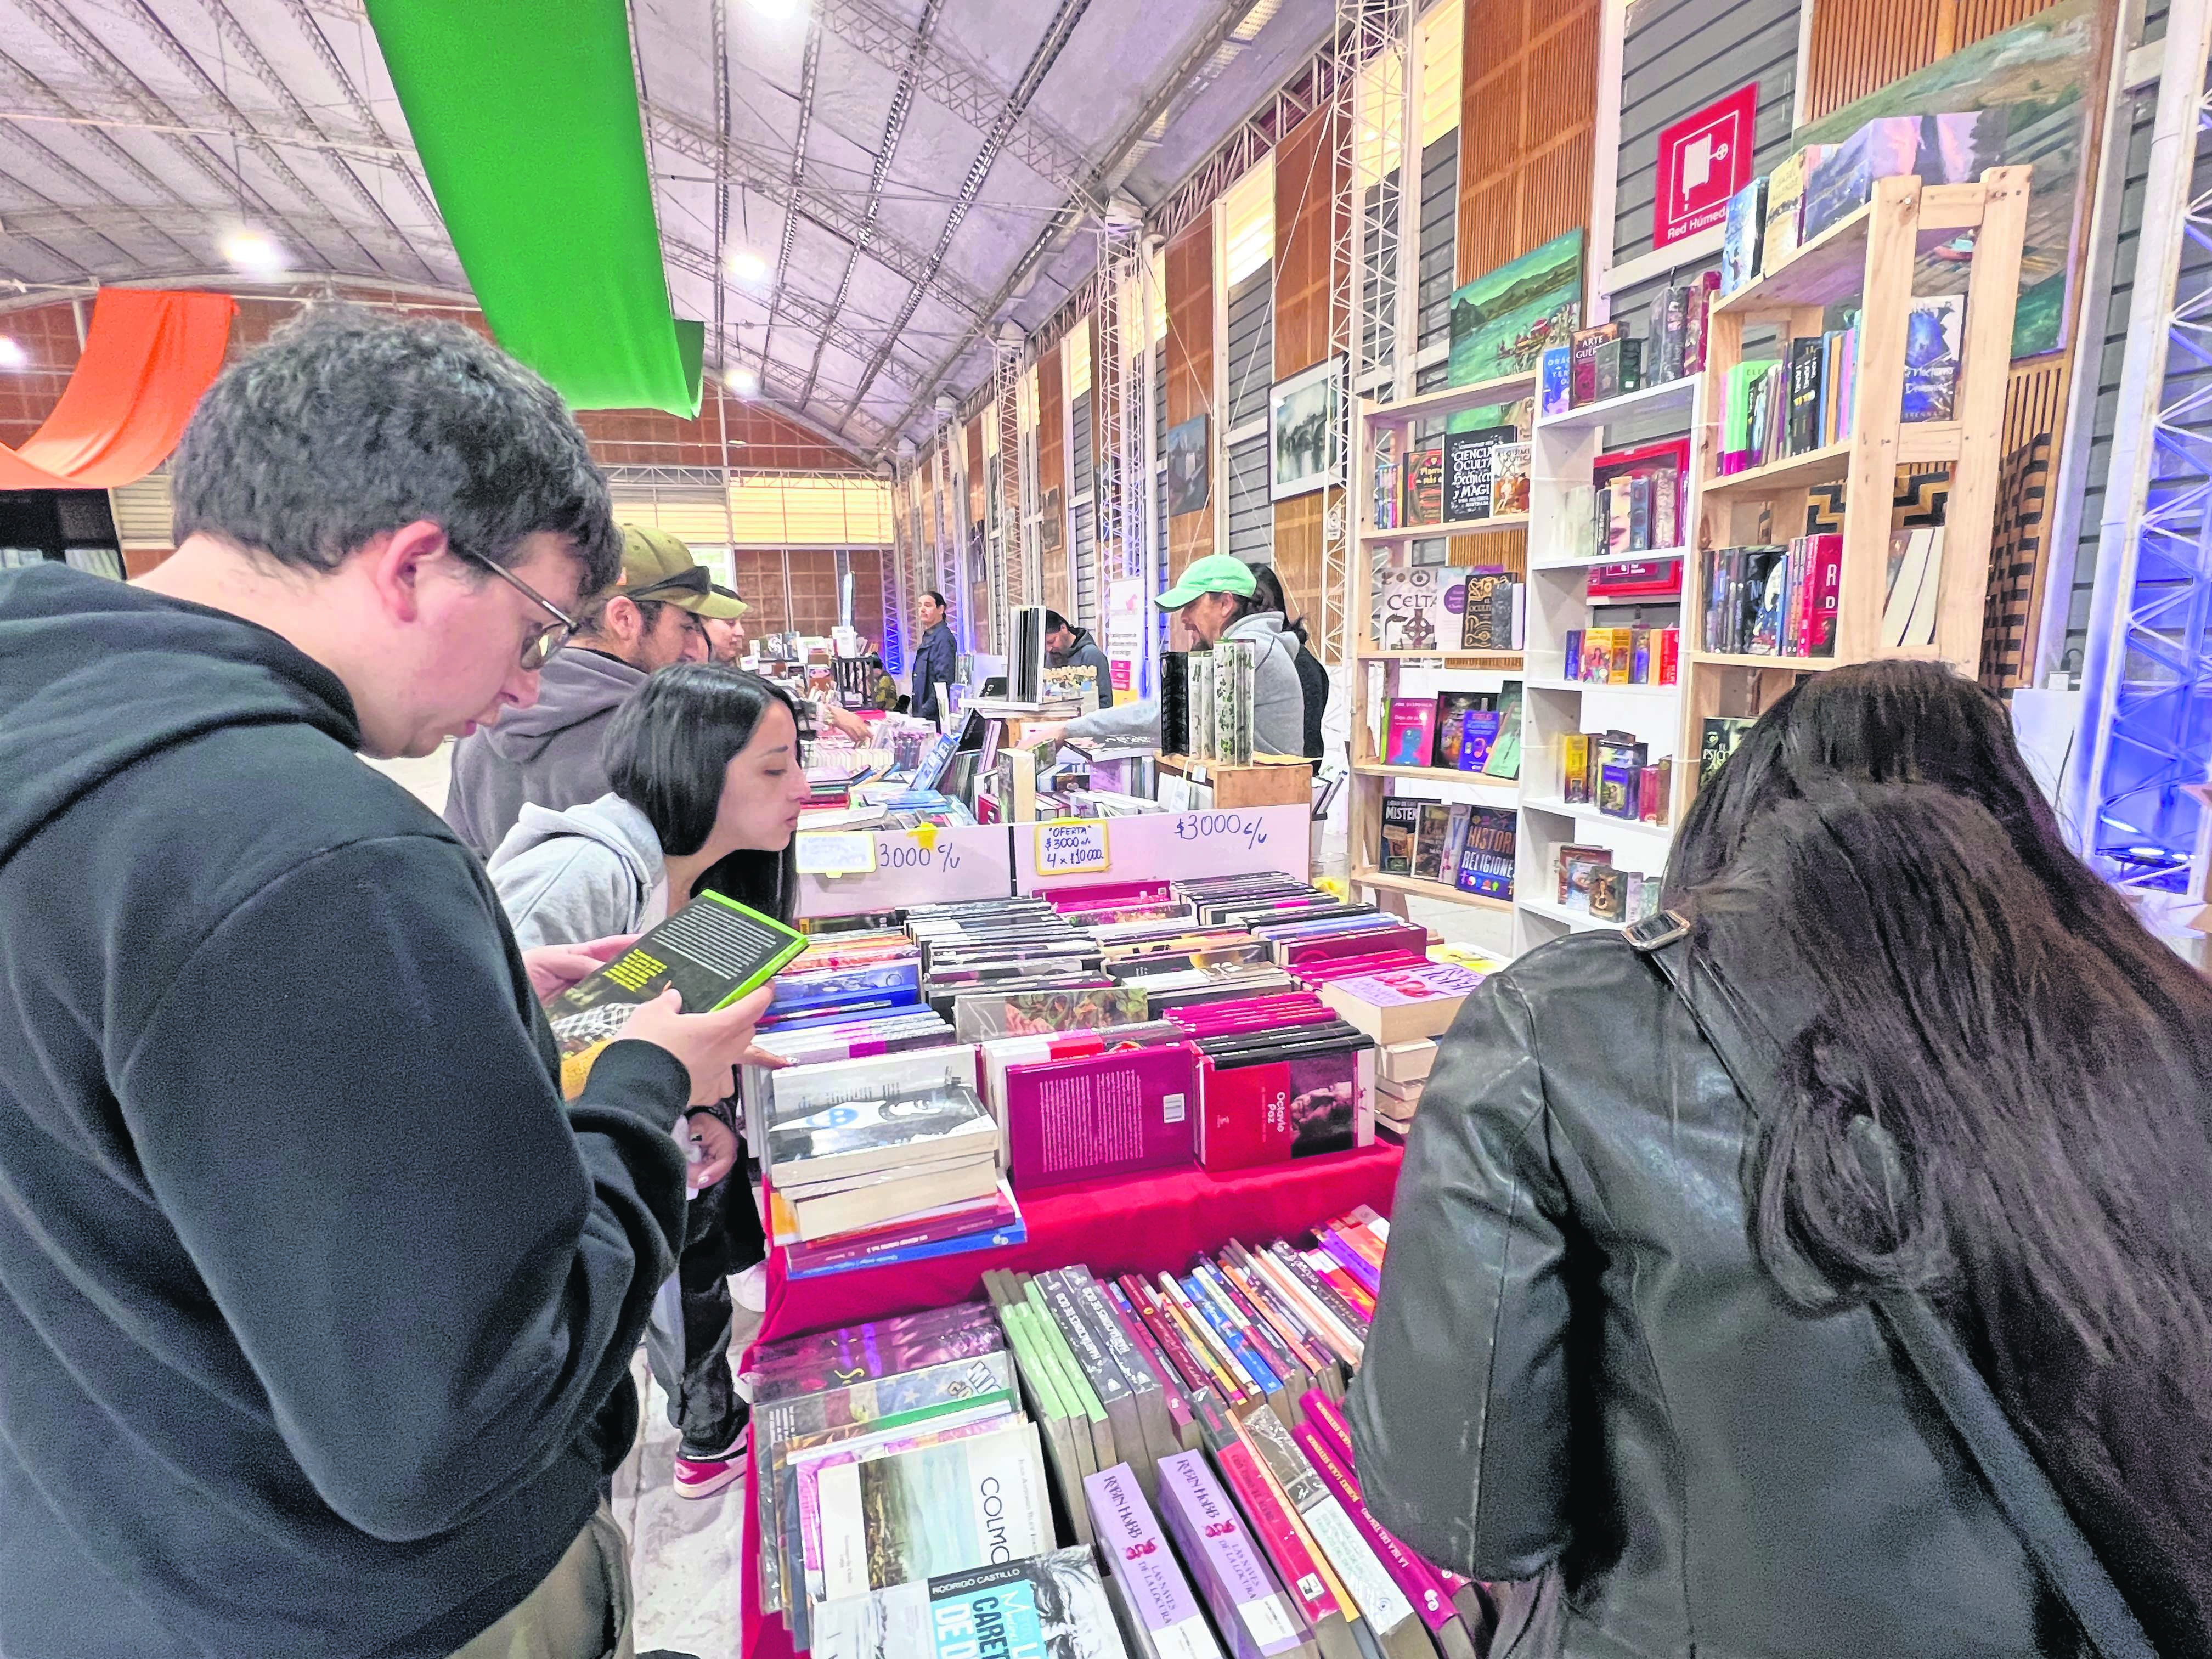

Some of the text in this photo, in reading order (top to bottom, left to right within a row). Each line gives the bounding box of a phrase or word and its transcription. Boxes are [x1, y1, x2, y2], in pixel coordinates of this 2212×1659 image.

[1668, 205, 1726, 240] Red Húmed
[1582, 335, 1603, 347] ARTE
[1460, 484, 1490, 498] MAGI
[1173, 815, 1241, 840] $3000
[1047, 853, 1057, 868] 4
[1267, 1104, 1277, 1124] Paz
[1276, 1092, 1286, 1132] Octavio
[1176, 1459, 1202, 1488] ROBIN
[1305, 1433, 1361, 1502] ROBERT LOUIS STEVENSON
[1104, 1475, 1128, 1507] ROBIN
[1378, 1532, 1392, 1545] DEL
[1387, 1542, 1402, 1559] ISLA
[1218, 1539, 1257, 1599] DE LA LOCURA
[1232, 1543, 1260, 1587] LAS NAVES
[1397, 1556, 1409, 1568] LA
[932, 1568, 1020, 1595] RODRIGO CASTILLO
[1138, 1561, 1172, 1624] DE LA LOCURA
[1151, 1565, 1176, 1611] LAS NAVES
[935, 1601, 975, 1642] DE
